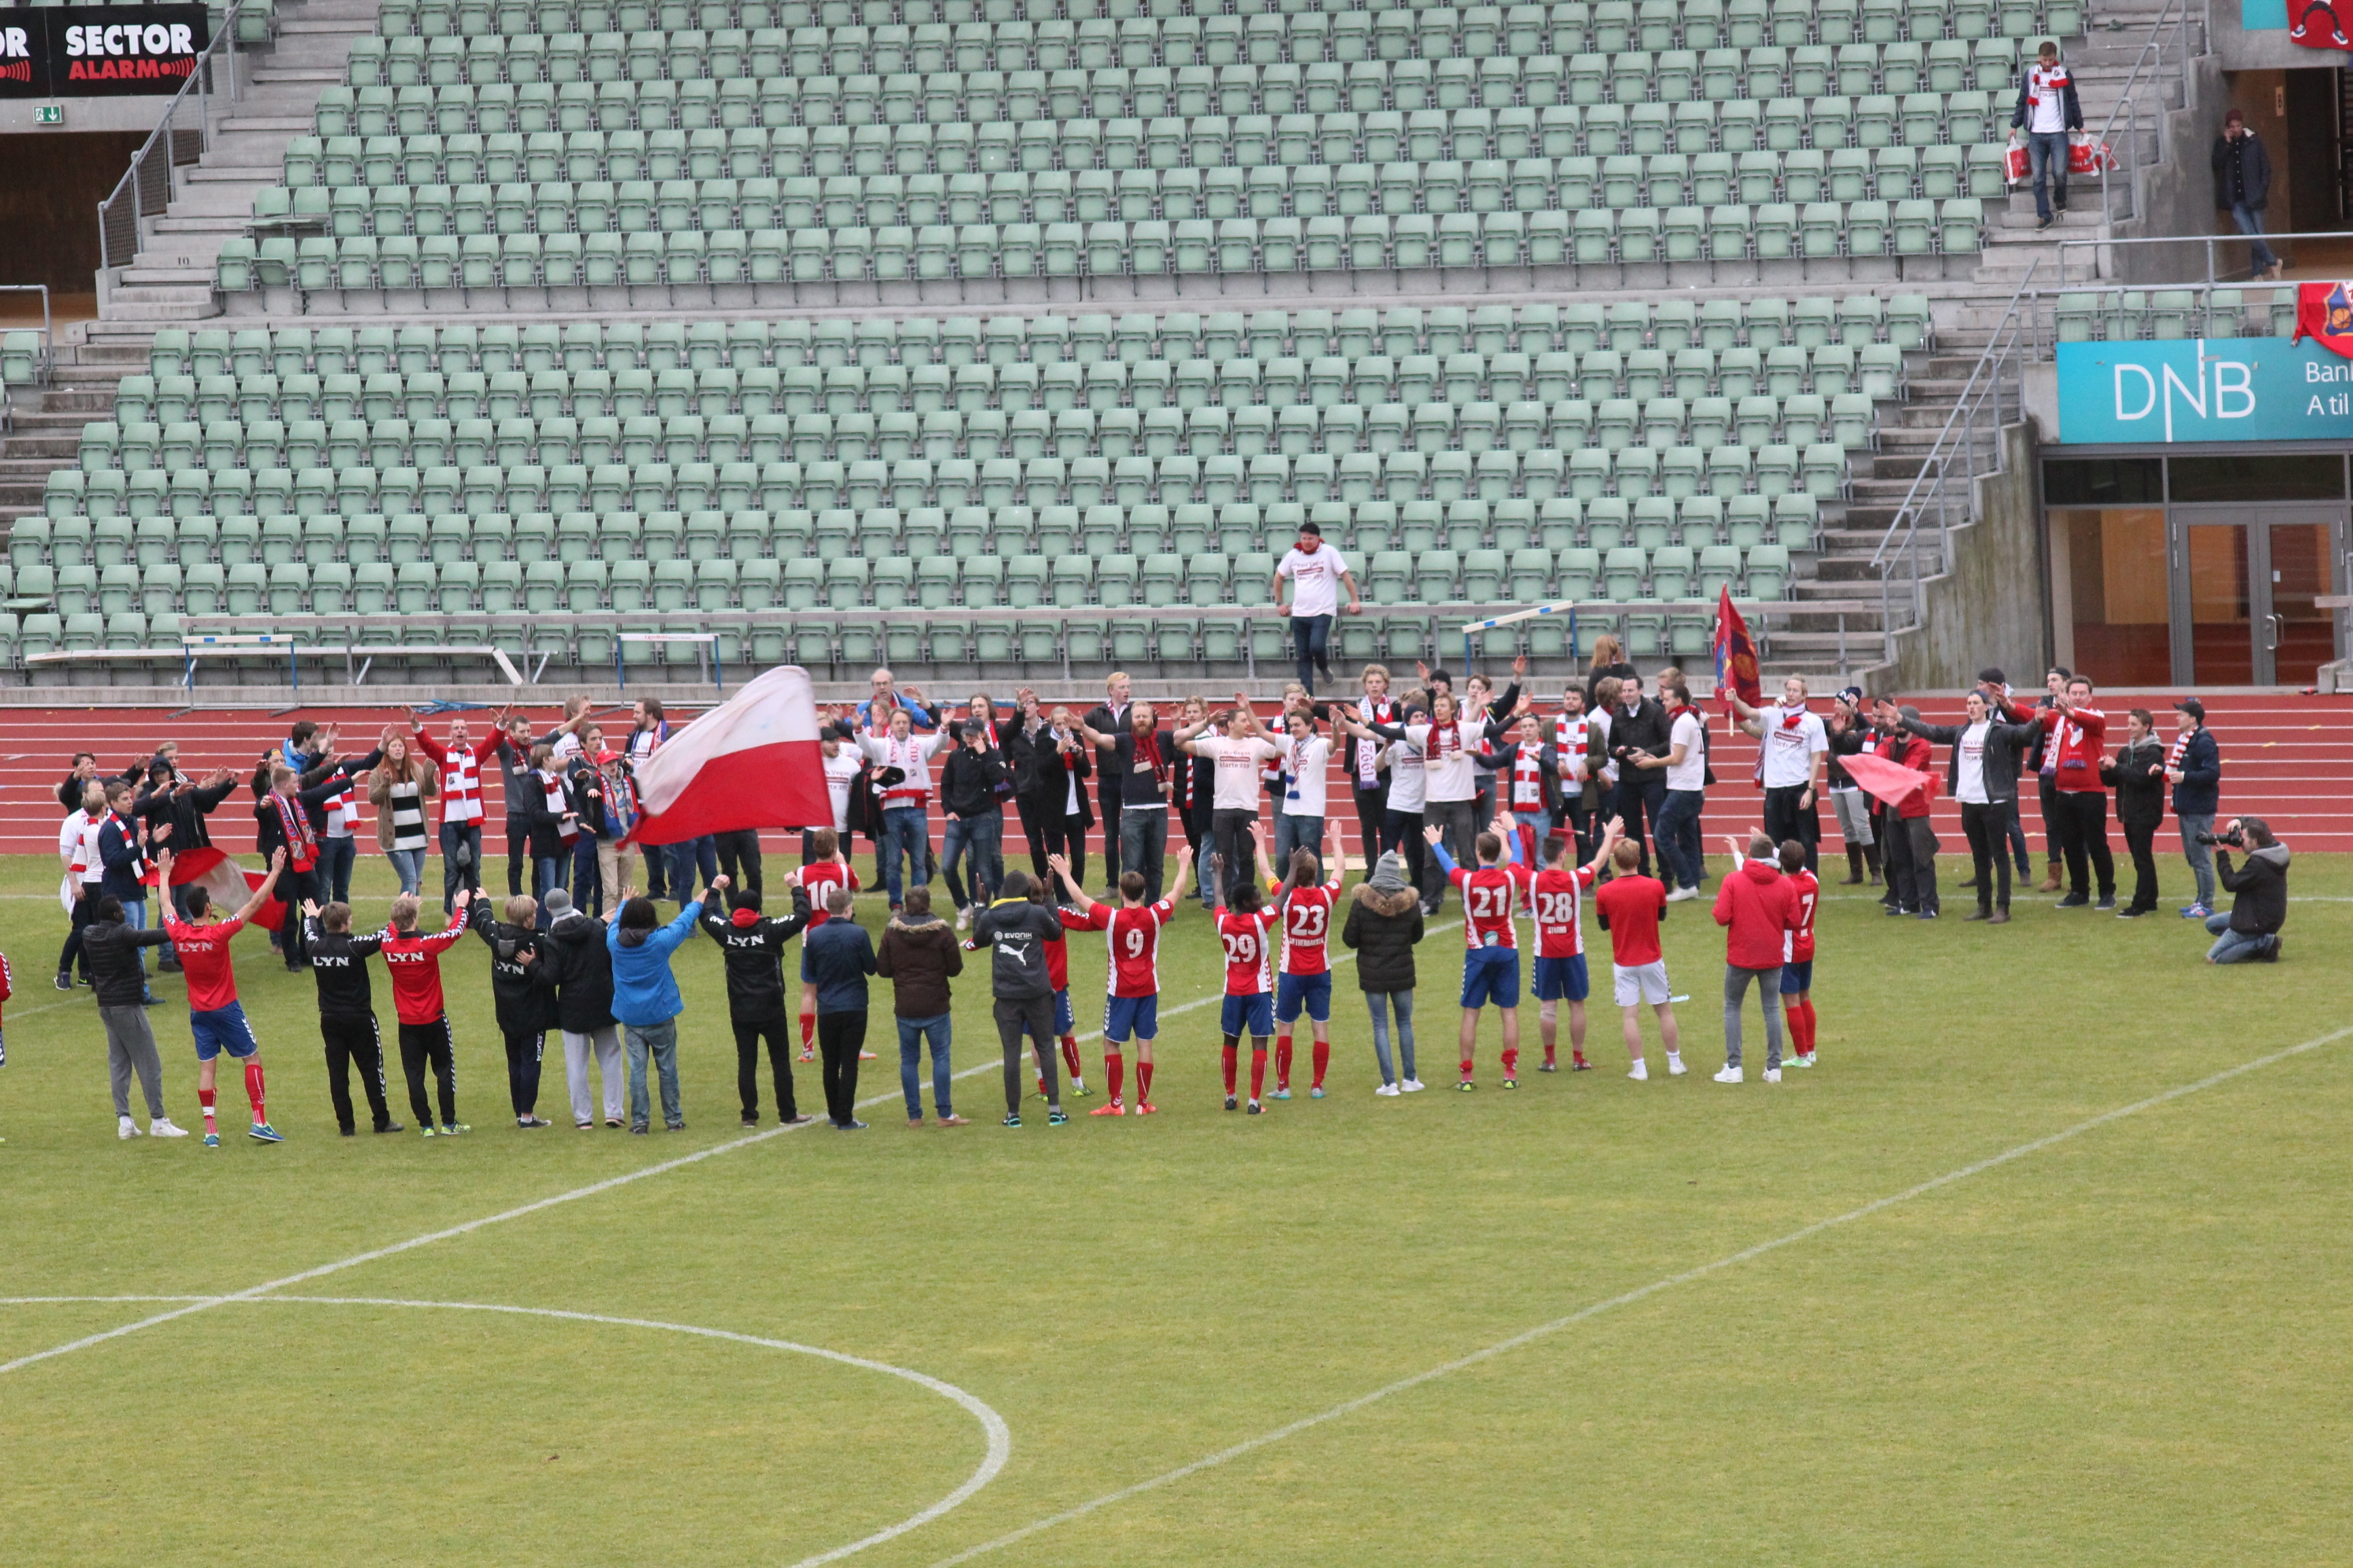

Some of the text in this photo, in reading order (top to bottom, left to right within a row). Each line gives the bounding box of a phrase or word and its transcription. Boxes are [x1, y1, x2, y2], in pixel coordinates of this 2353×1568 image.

[65, 24, 194, 56] SECTOR
[69, 59, 160, 79] ALARM
[2114, 338, 2256, 443] DNB
[2307, 393, 2349, 416] A til
[806, 880, 838, 911] 10
[1473, 884, 1507, 917] 21
[1539, 892, 1573, 924] 28
[1801, 893, 1814, 926] 7
[1291, 905, 1325, 936] 23
[179, 942, 213, 952] LYN
[726, 934, 765, 947] LYN
[1126, 928, 1144, 958] 9
[1223, 934, 1256, 963] 29
[312, 956, 349, 966] LYN
[386, 951, 425, 962] LYN
[494, 959, 525, 974] LYN
